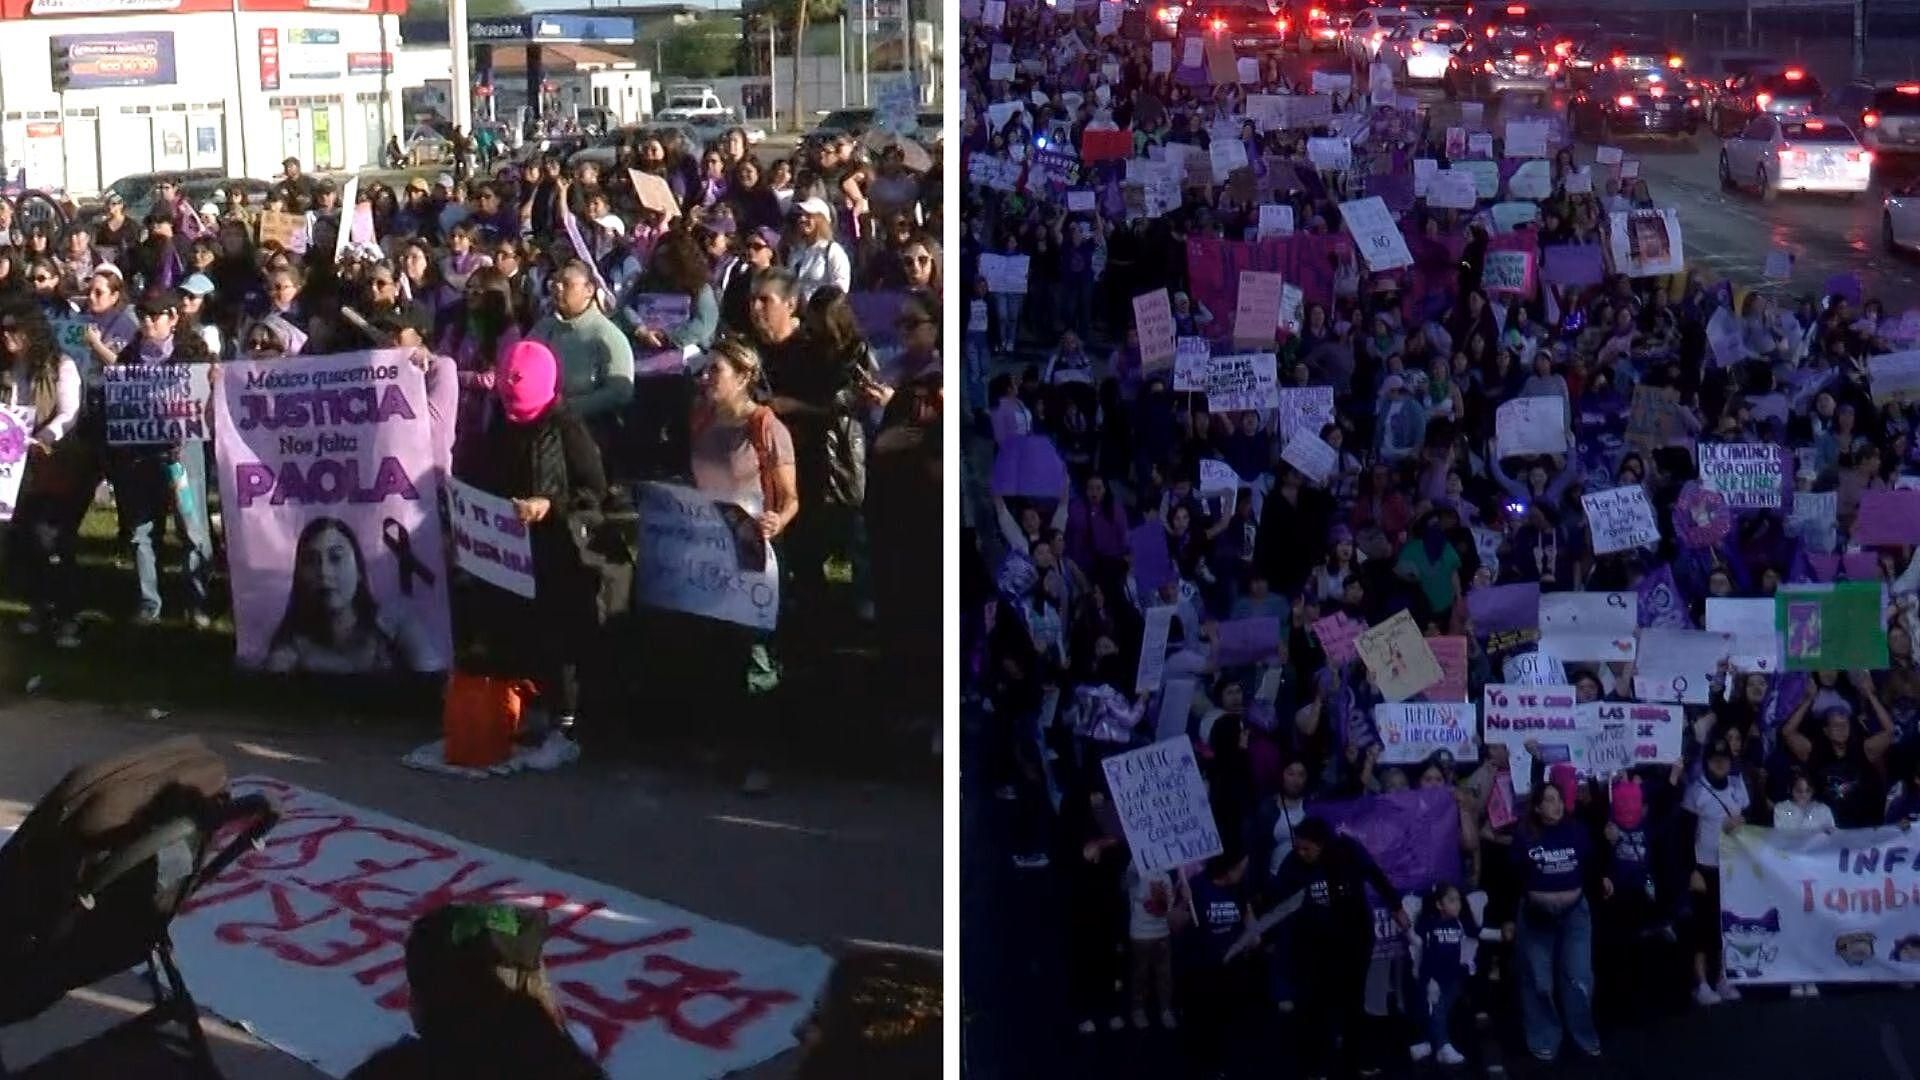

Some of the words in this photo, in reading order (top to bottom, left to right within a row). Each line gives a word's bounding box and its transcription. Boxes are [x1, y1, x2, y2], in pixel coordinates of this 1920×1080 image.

[246, 369, 309, 389] México
[312, 365, 398, 388] queremos
[240, 385, 416, 430] JUSTICIA
[280, 434, 313, 455] Nos
[316, 432, 359, 456] falta
[236, 457, 420, 507] PAOLA
[1599, 706, 1625, 720] LAS
